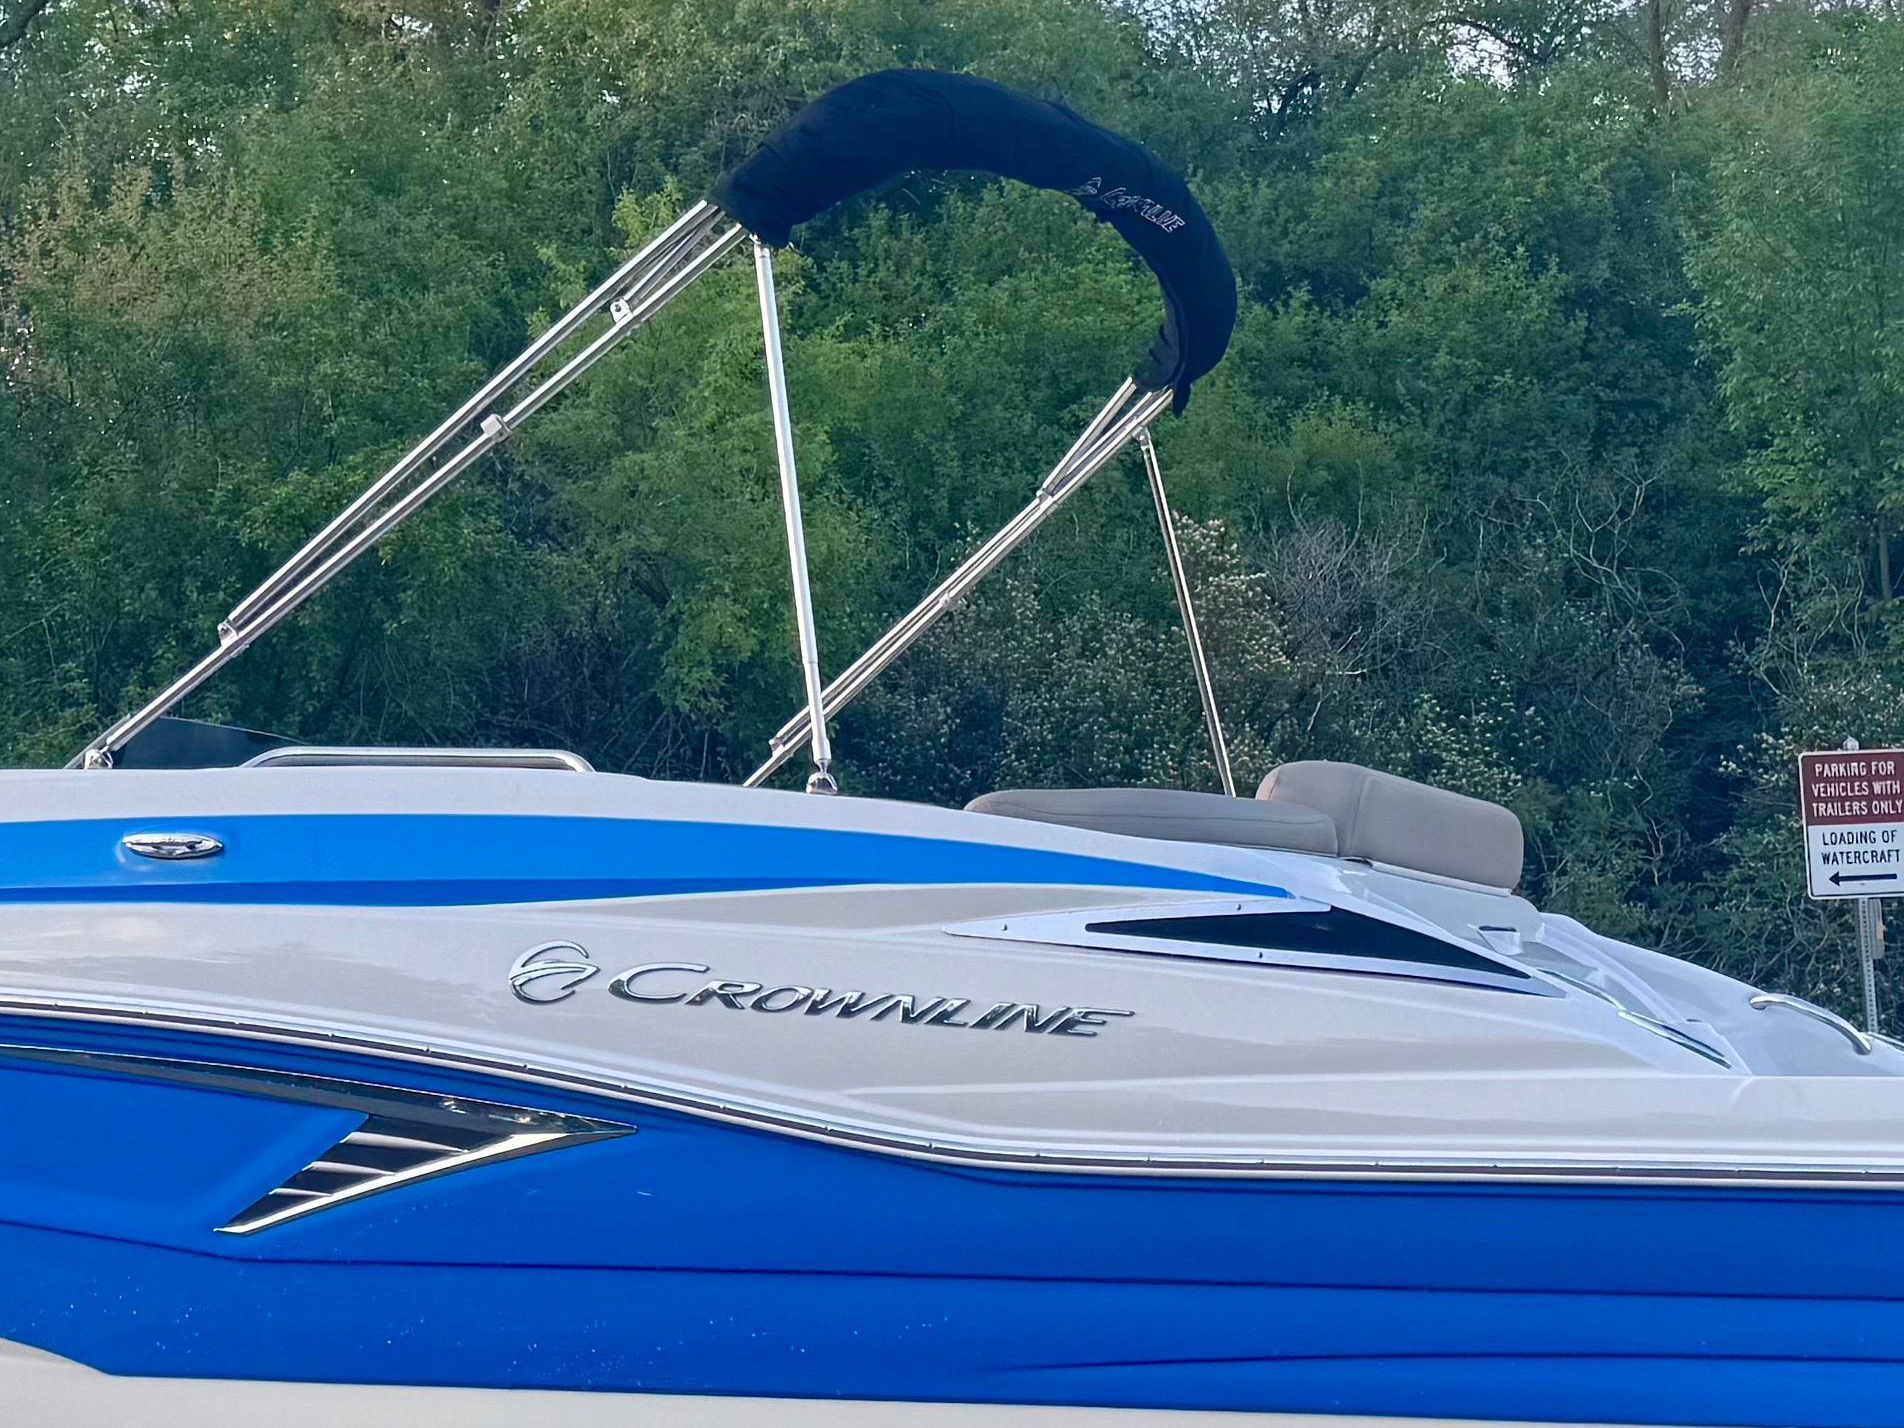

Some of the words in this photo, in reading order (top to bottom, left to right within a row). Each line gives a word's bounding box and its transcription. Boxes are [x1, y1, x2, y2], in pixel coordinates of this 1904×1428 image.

[1815, 762, 1867, 777] PARKING
[1872, 761, 1895, 776] FOR
[1812, 781, 1869, 798] VEHICLES
[1872, 780, 1901, 796] WITH
[1812, 801, 1868, 817] TRAILERS
[1872, 800, 1903, 815] ONLY
[1822, 831, 1876, 846] LOADING
[1882, 830, 1898, 843] OF
[1821, 849, 1901, 865] WATERCRAFT
[607, 961, 1135, 1038] CROWNLINE
